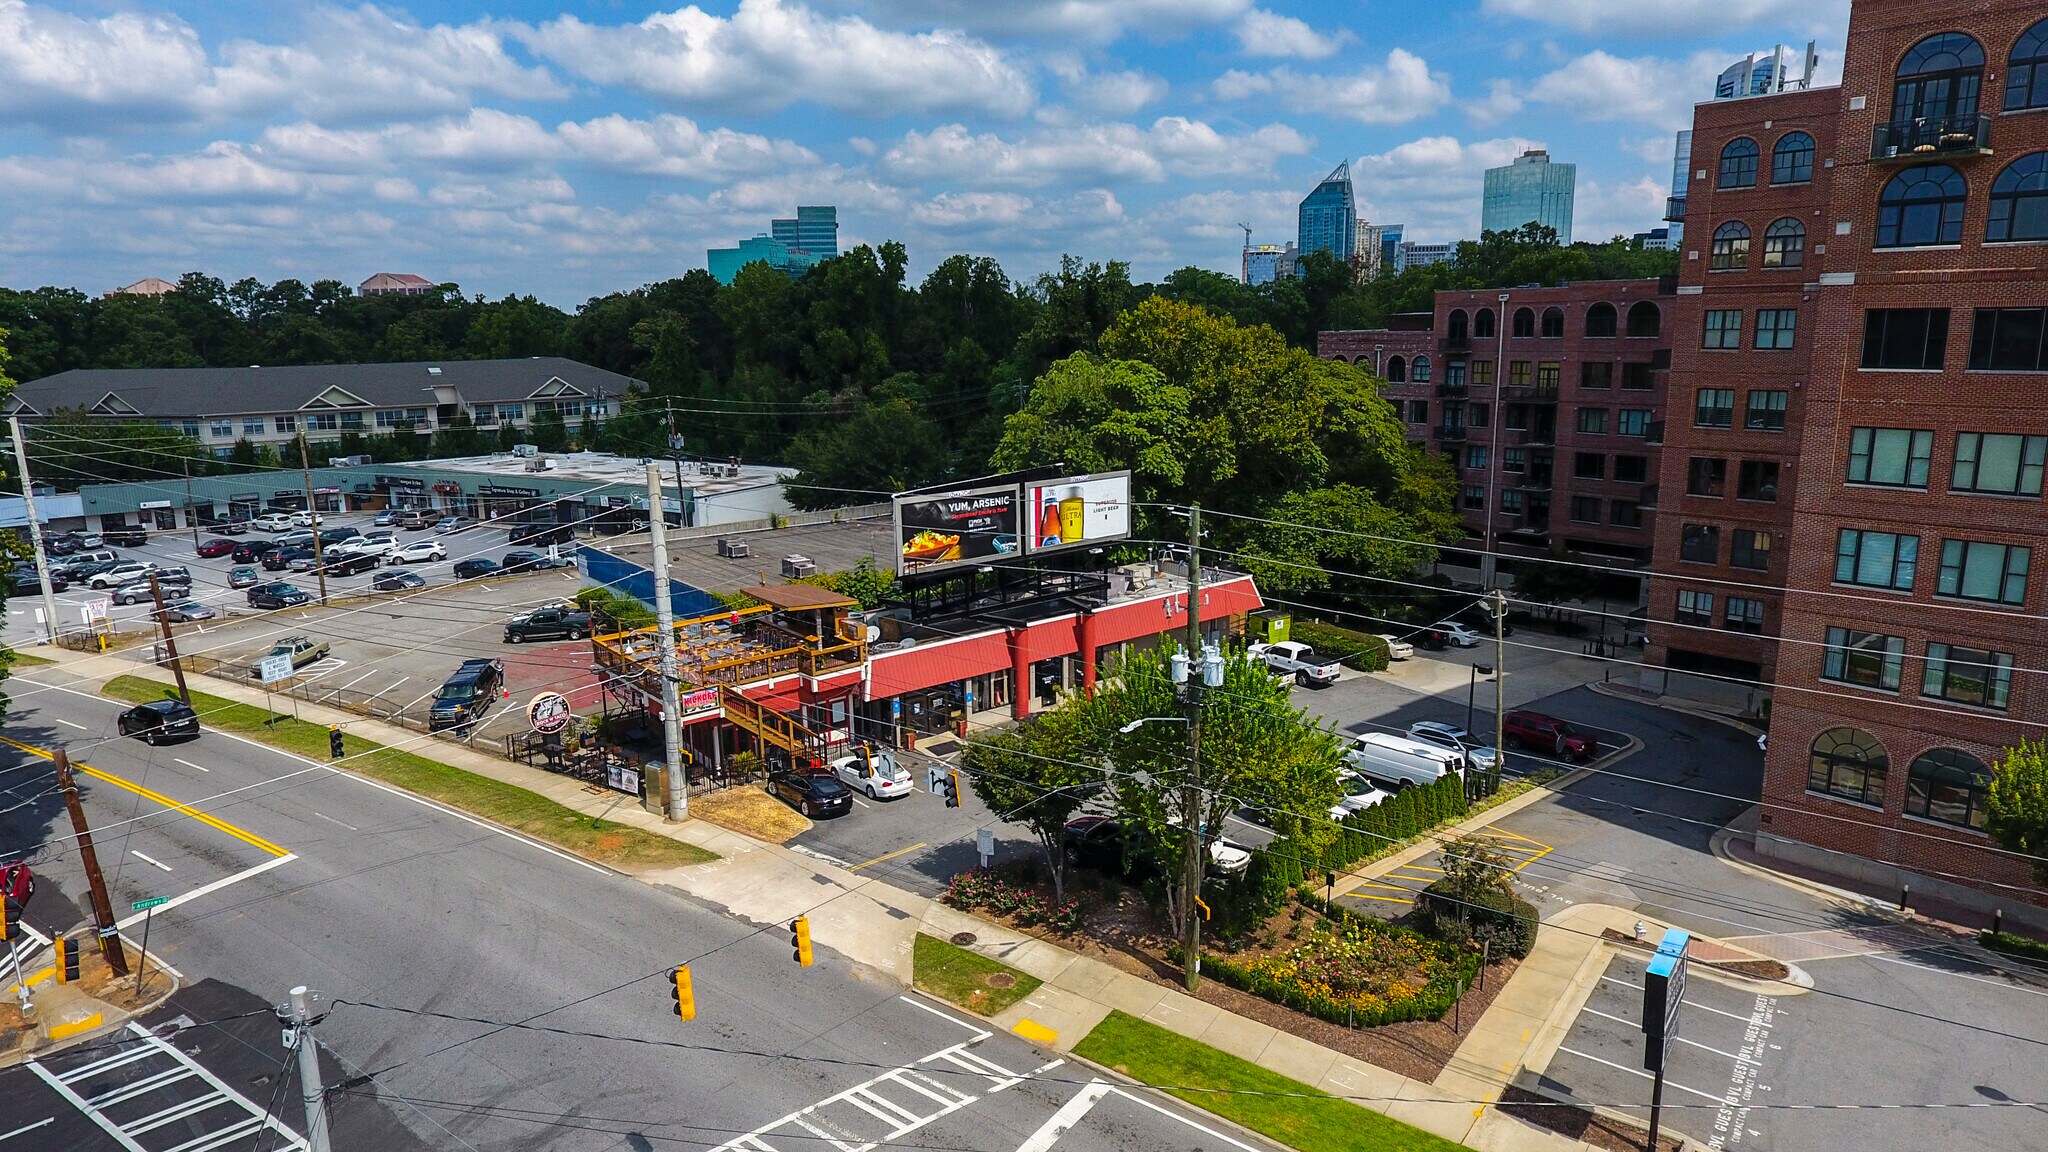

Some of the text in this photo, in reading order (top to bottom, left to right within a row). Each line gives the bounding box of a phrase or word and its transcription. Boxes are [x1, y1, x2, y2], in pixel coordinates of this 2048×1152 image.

[948, 496, 1010, 512] YUM, ARSENIC
[1061, 511, 1082, 520] ULTRA
[684, 692, 717, 706] KICKOFF
[136, 899, 162, 909] Andrews
[1738, 1022, 1762, 1060] BVL GUEST
[1726, 1060, 1750, 1103] BVL GUEST
[1742, 1068, 1758, 1101] COMPACT CAR
[1758, 1084, 1772, 1092] 5
[1731, 1118, 1745, 1143] COMPACT
[1748, 1128, 1761, 1137] 4
[1708, 1134, 1726, 1150] BVL
